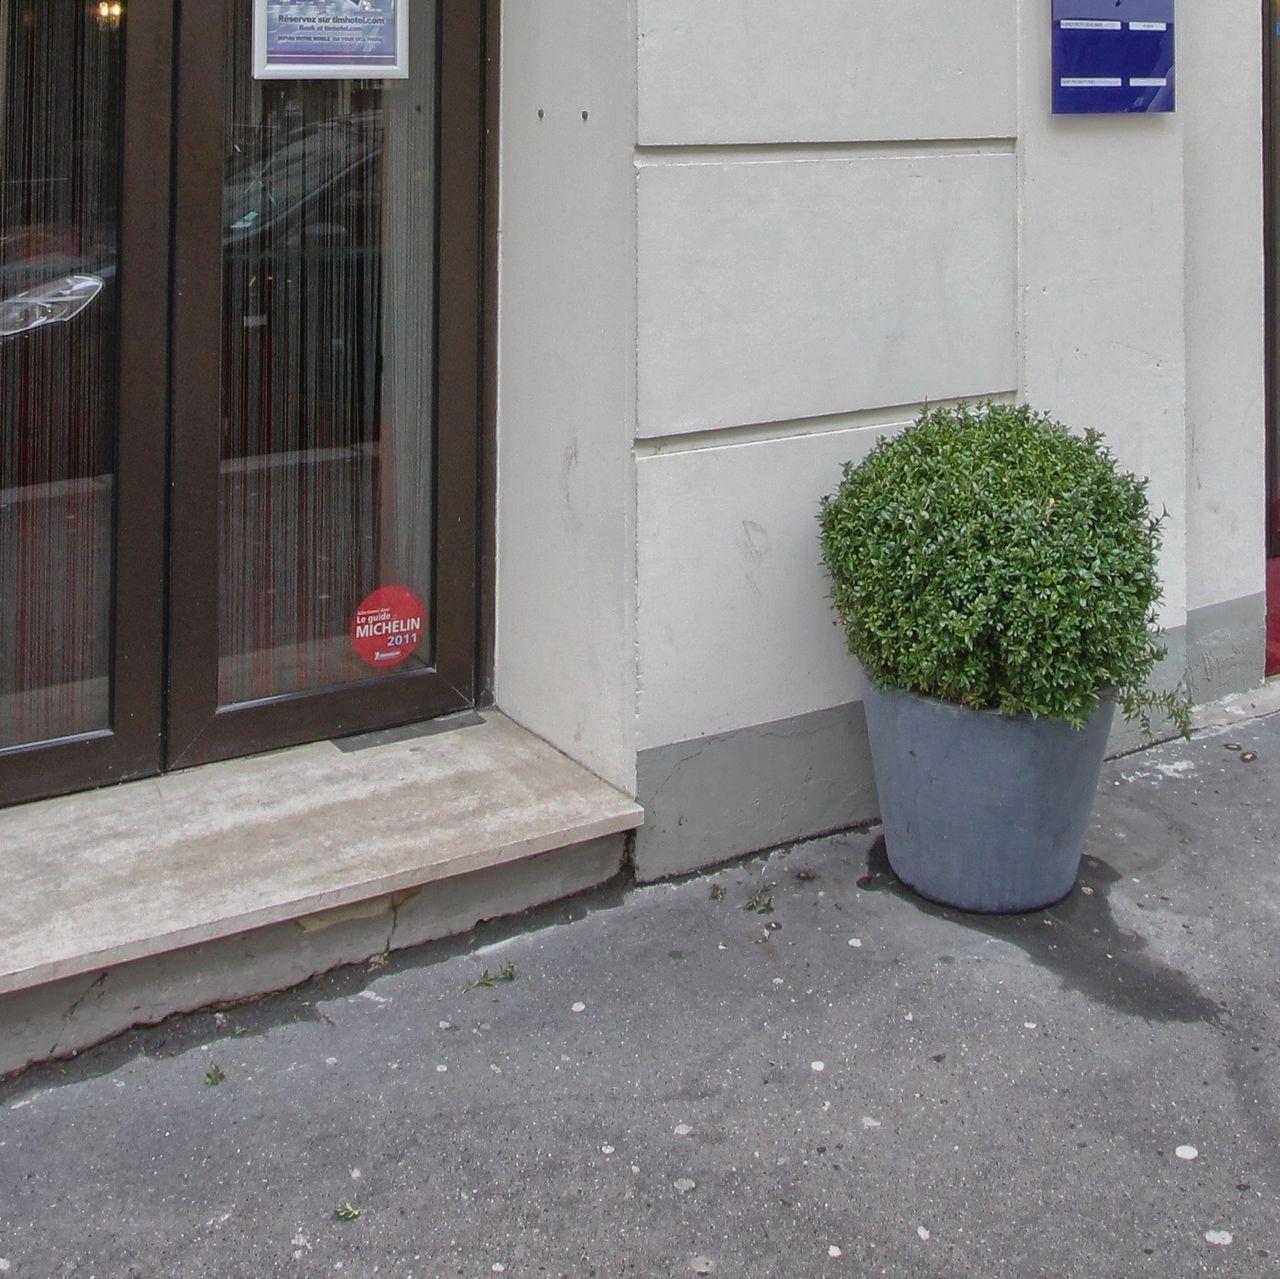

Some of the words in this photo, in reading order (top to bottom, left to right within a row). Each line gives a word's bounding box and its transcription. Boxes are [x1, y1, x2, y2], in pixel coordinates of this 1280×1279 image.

[278, 14, 317, 24] Réservez
[318, 16, 331, 24] sur
[332, 15, 385, 25] timhotel.com
[356, 615, 367, 625] Le
[367, 611, 392, 625] guide
[355, 616, 421, 639] MICHELIN
[387, 632, 418, 648] 2011
